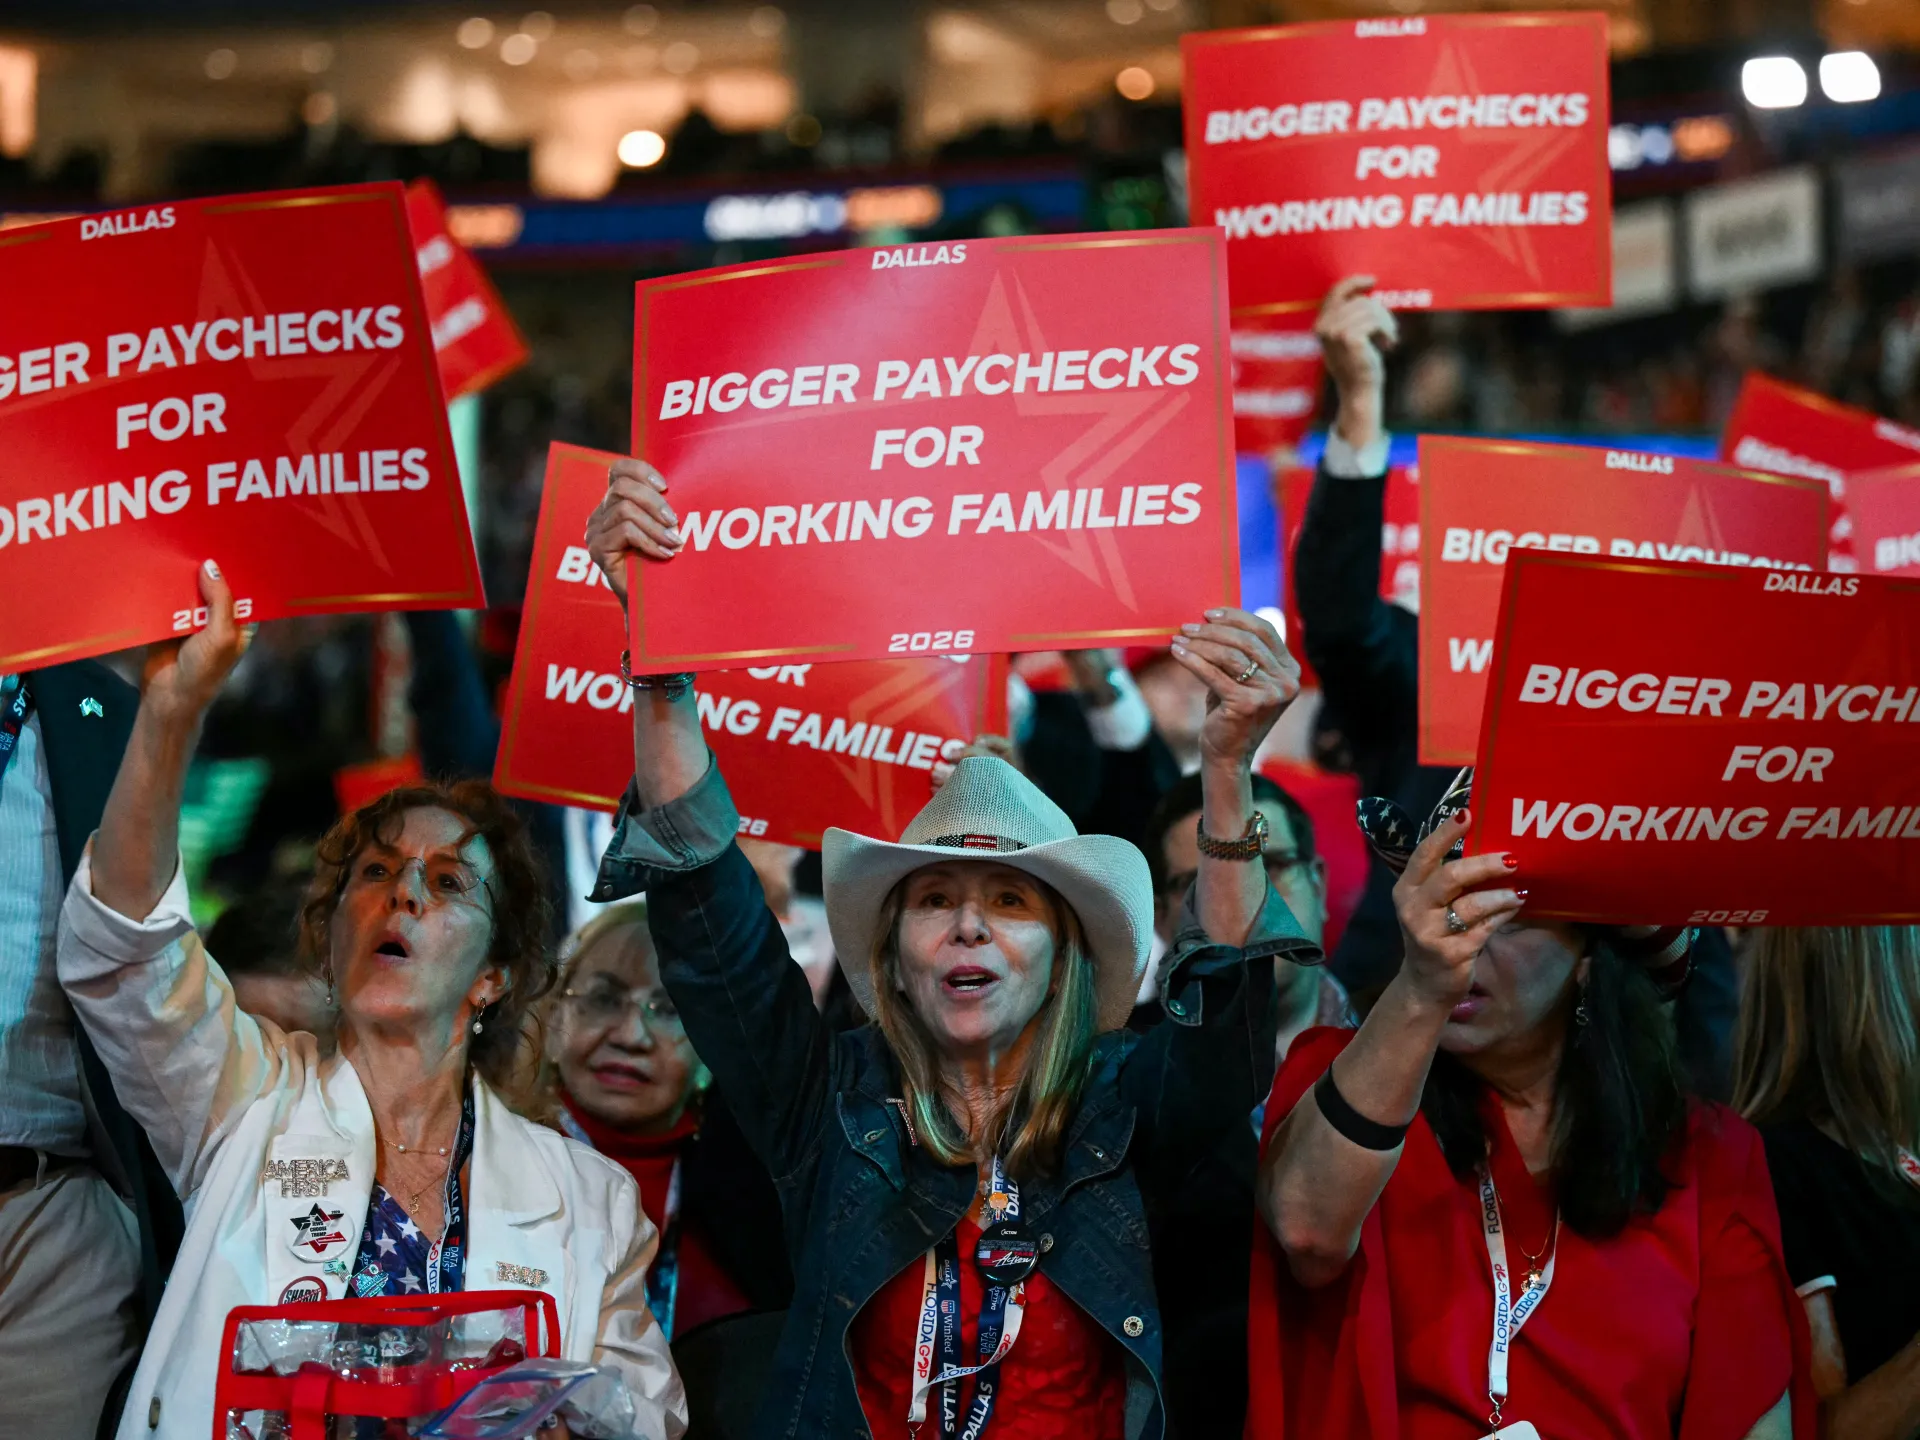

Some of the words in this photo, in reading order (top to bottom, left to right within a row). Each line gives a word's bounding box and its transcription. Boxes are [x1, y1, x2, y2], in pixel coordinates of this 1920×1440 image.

[1356, 17, 1426, 38] DALLAS
[1205, 100, 1352, 144] BIGGER
[1357, 93, 1589, 131] PAYCHECKS
[1356, 145, 1439, 180] FOR
[81, 208, 176, 241] DALLAS
[1215, 197, 1403, 239] WORKING
[1410, 191, 1588, 226] FAMILIES
[872, 244, 967, 269] DALLAS
[107, 305, 405, 378] PAYCHECKS
[659, 363, 860, 420] BIGGER
[873, 344, 1200, 401] PAYCHECKS
[116, 393, 227, 449] FOR
[870, 424, 985, 470] FOR
[1605, 450, 1674, 475] DALLAS
[206, 448, 430, 505] FAMILIES
[674, 496, 933, 552] WORKING
[947, 483, 1203, 536] FAMILIES
[1763, 572, 1860, 597] DALLAS
[173, 599, 253, 631] 206
[888, 630, 975, 653] 2026
[1519, 664, 1732, 717] BIGGER
[767, 708, 967, 770] FAMILIES
[1721, 745, 1835, 784] FOR
[1510, 798, 1769, 842] WORKING
[1686, 908, 1771, 926] 2026
[264, 1158, 350, 1181] AMERICA
[281, 1179, 329, 1198] FIRST
[450, 1178, 461, 1226] ALLAS
[992, 1251, 1033, 1267] Action
[943, 1314, 954, 1354] WinRed
